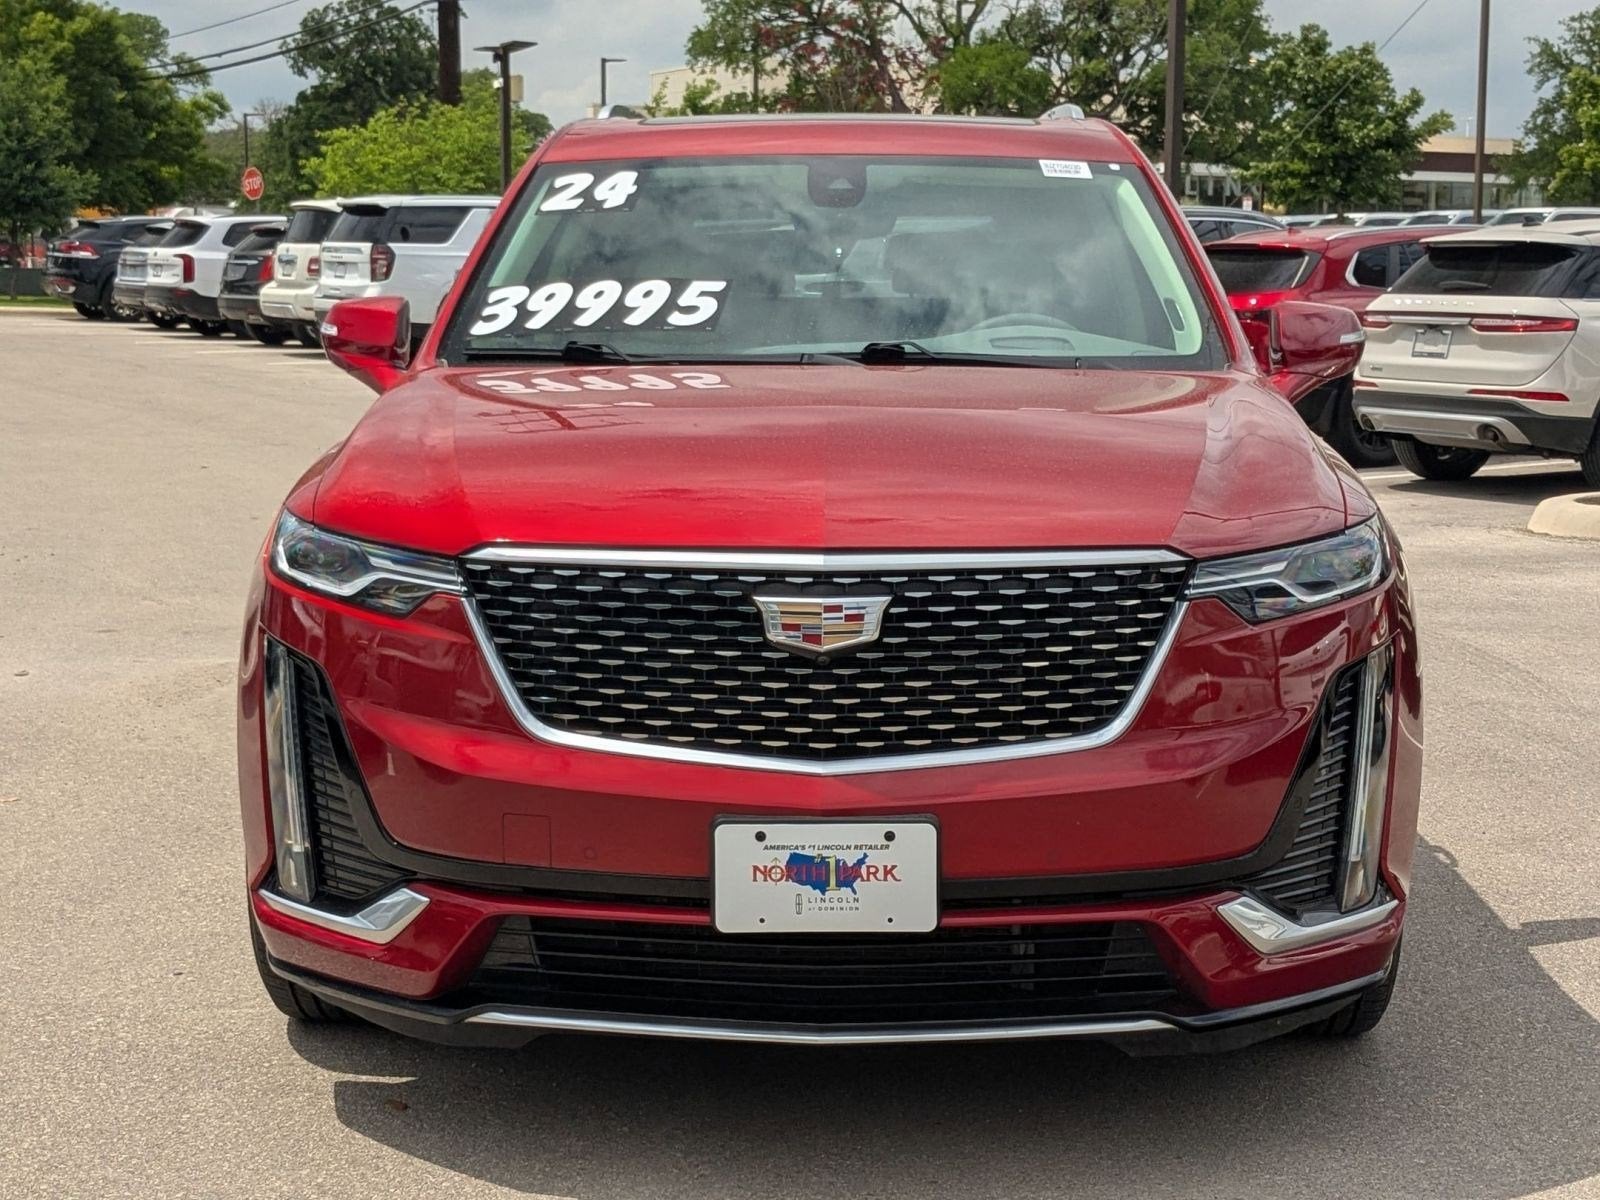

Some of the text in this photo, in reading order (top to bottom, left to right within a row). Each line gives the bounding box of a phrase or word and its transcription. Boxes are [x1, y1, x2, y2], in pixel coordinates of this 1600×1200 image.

[244, 177, 262, 191] STOP
[540, 171, 638, 212] 24
[469, 280, 727, 336] 39995
[752, 864, 902, 883] NORTH PARK
